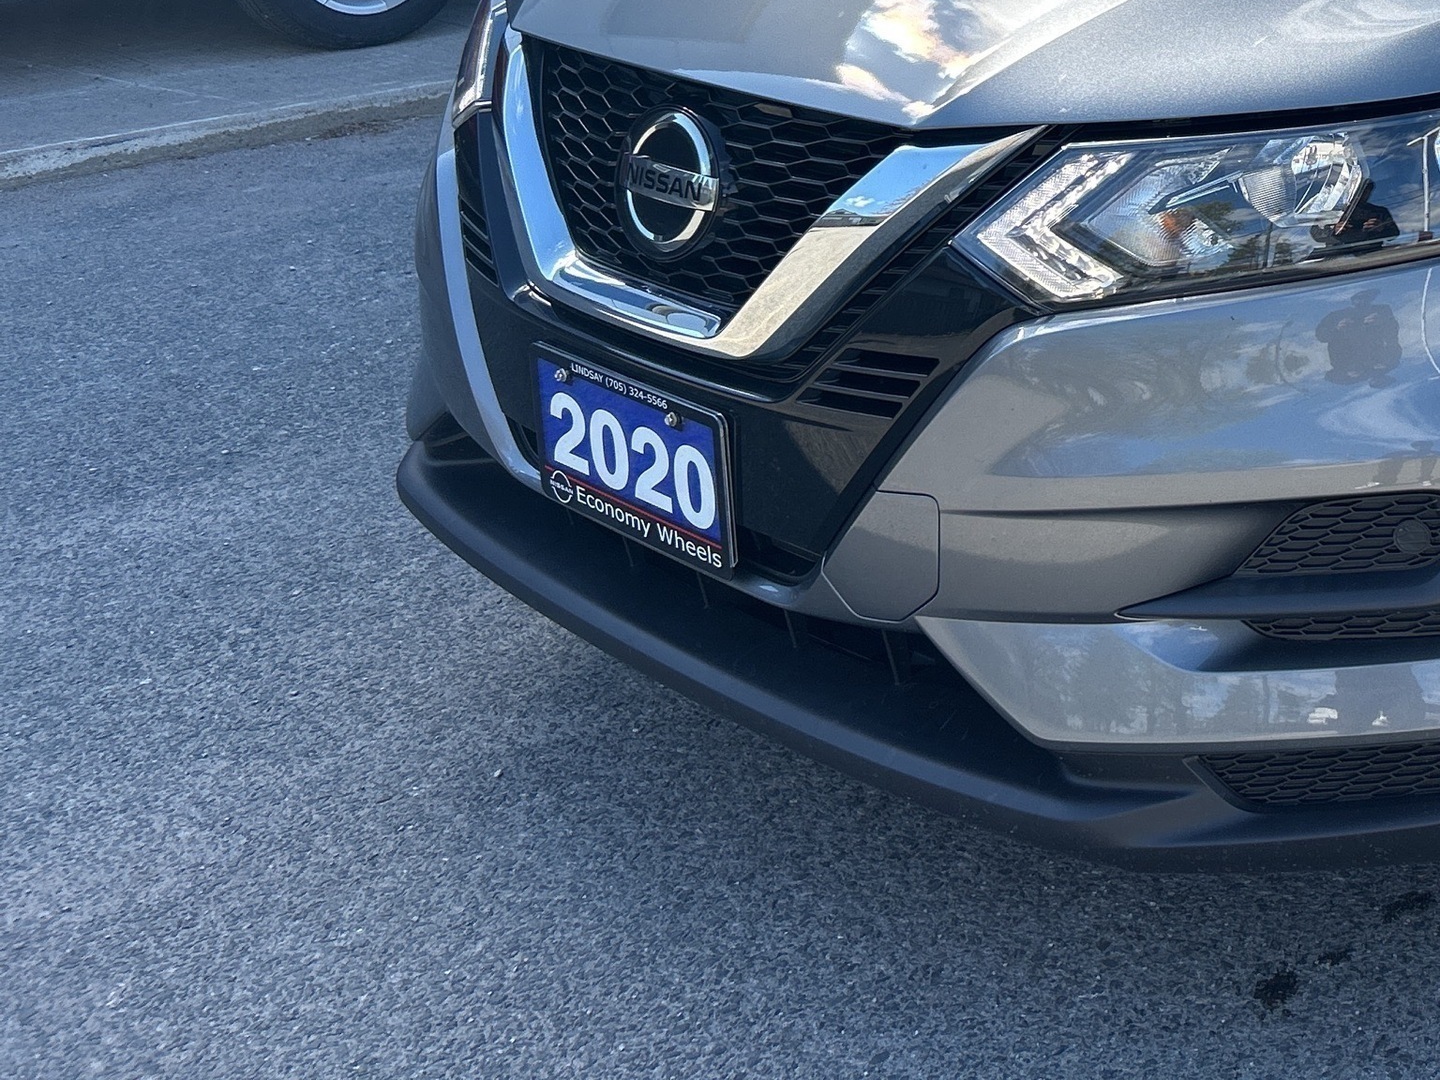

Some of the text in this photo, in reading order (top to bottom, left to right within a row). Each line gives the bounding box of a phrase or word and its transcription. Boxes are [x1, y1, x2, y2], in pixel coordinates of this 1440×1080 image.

[628, 162, 701, 201] NISSAN
[571, 362, 668, 410] LINDSAY (705) 324-5566
[549, 392, 716, 530] 2020
[576, 485, 723, 568] Economy Wheels
